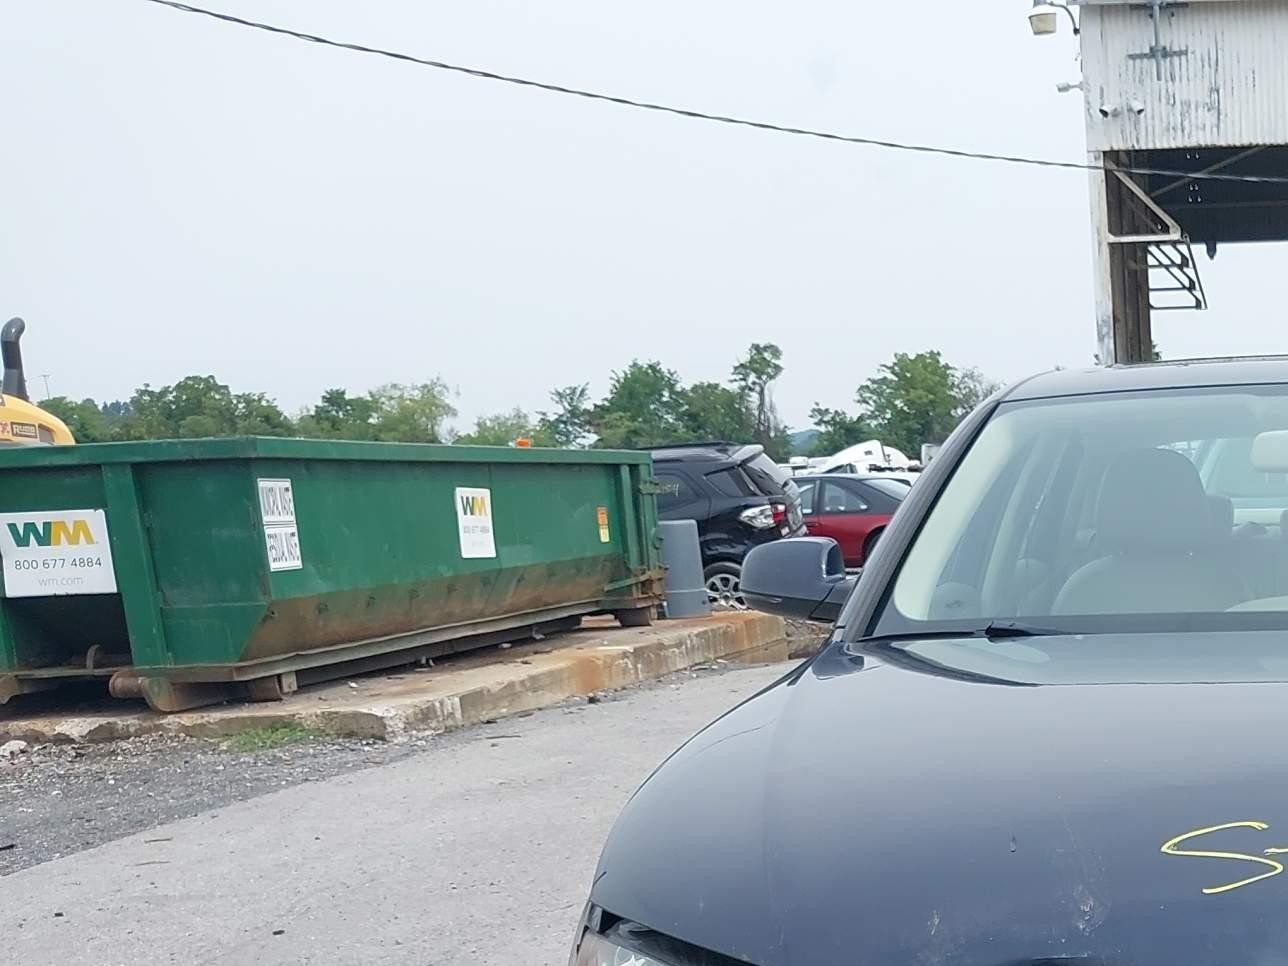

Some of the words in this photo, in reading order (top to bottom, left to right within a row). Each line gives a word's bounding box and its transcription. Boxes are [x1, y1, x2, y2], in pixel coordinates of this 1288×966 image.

[6, 519, 96, 548] WM
[14, 559, 39, 570] 800
[42, 558, 66, 569] 677
[70, 557, 102, 568] 4884
[38, 577, 84, 586] wm.com
